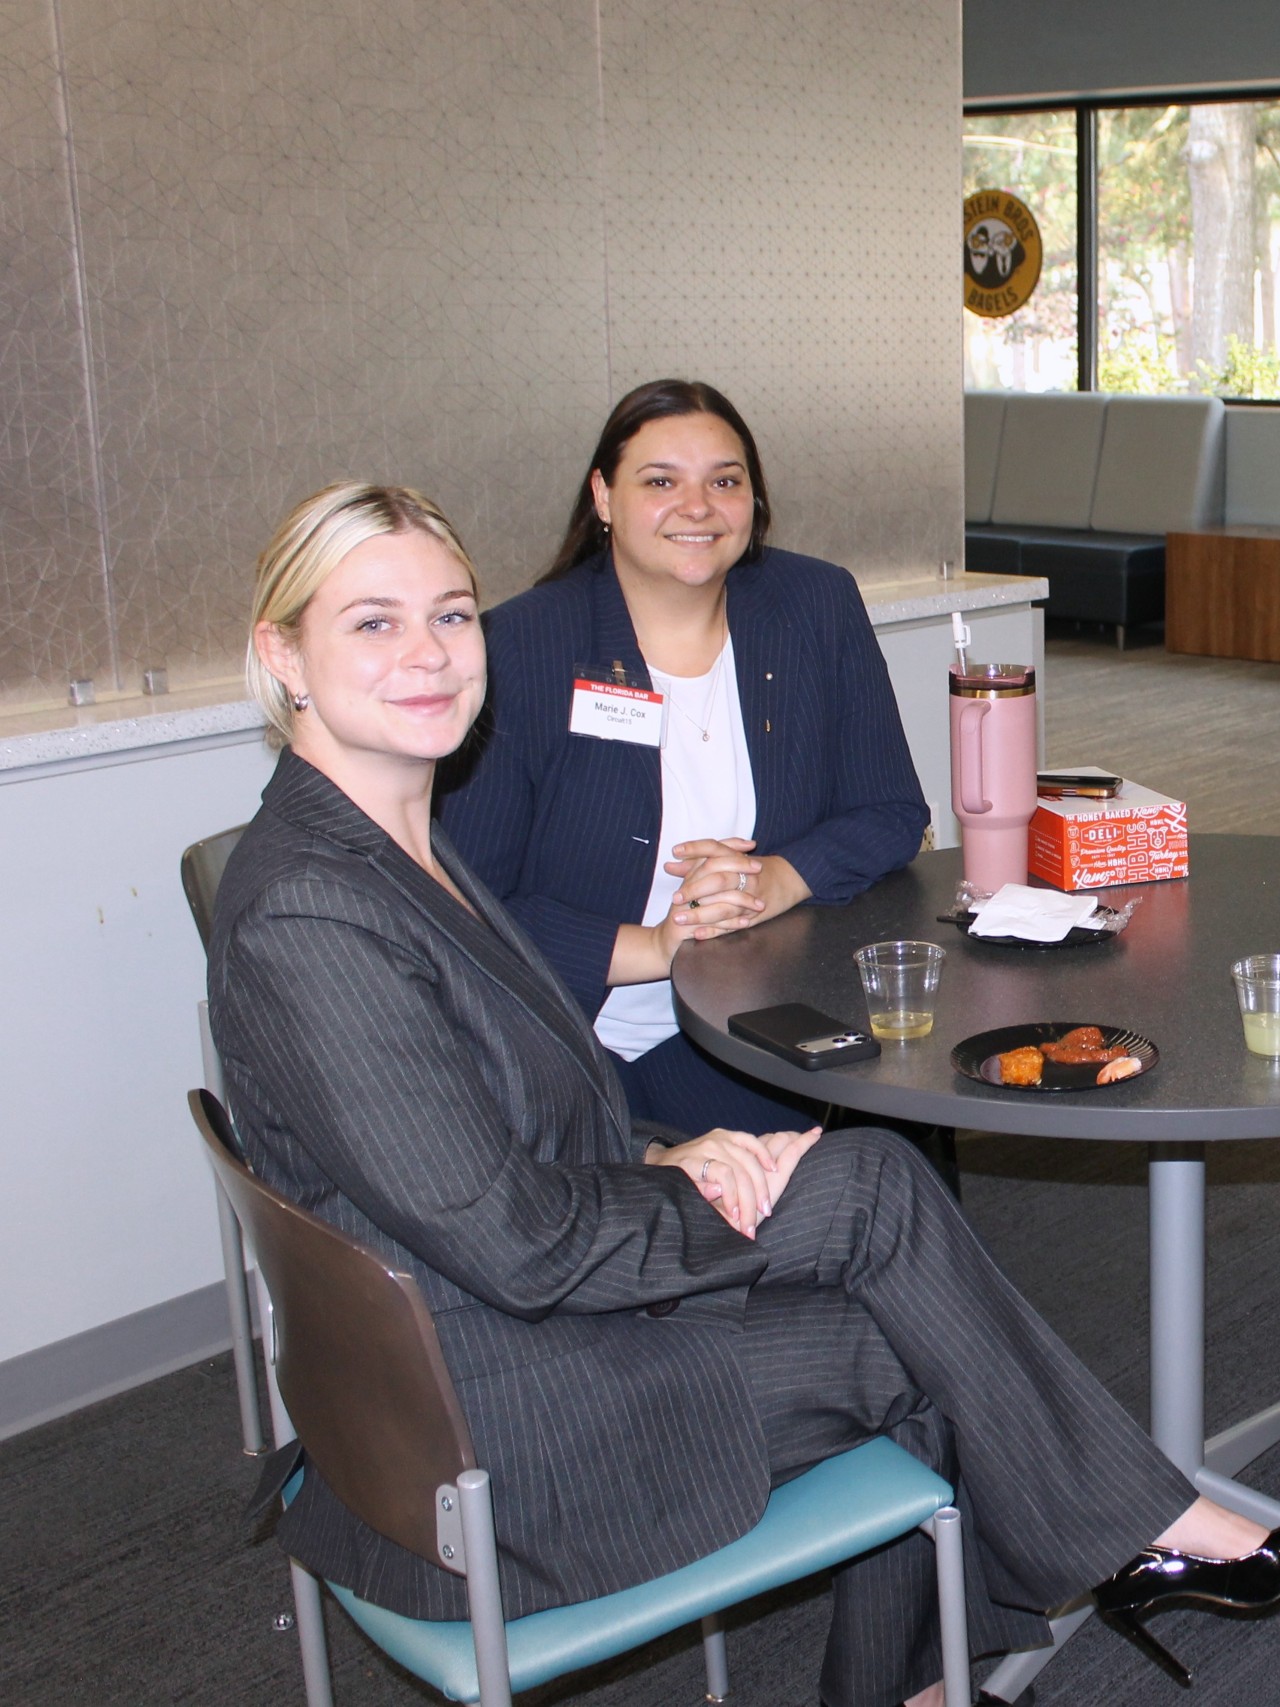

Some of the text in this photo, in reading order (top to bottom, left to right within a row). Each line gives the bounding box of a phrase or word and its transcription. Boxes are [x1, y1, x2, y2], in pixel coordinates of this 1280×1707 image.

[1003, 200, 1034, 241] BROS
[968, 287, 1019, 310] BAGELS
[590, 683, 649, 700] THE FLORIDA BAR
[594, 701, 647, 719] Marie J. Cox
[1077, 812, 1103, 823] HONEY
[1105, 809, 1131, 820] BAKED
[1088, 827, 1117, 841] DELI
[1080, 848, 1105, 856] Premium
[1106, 845, 1127, 854] Quality
[1149, 849, 1179, 863] Turkey
[1072, 868, 1110, 889] Ham
